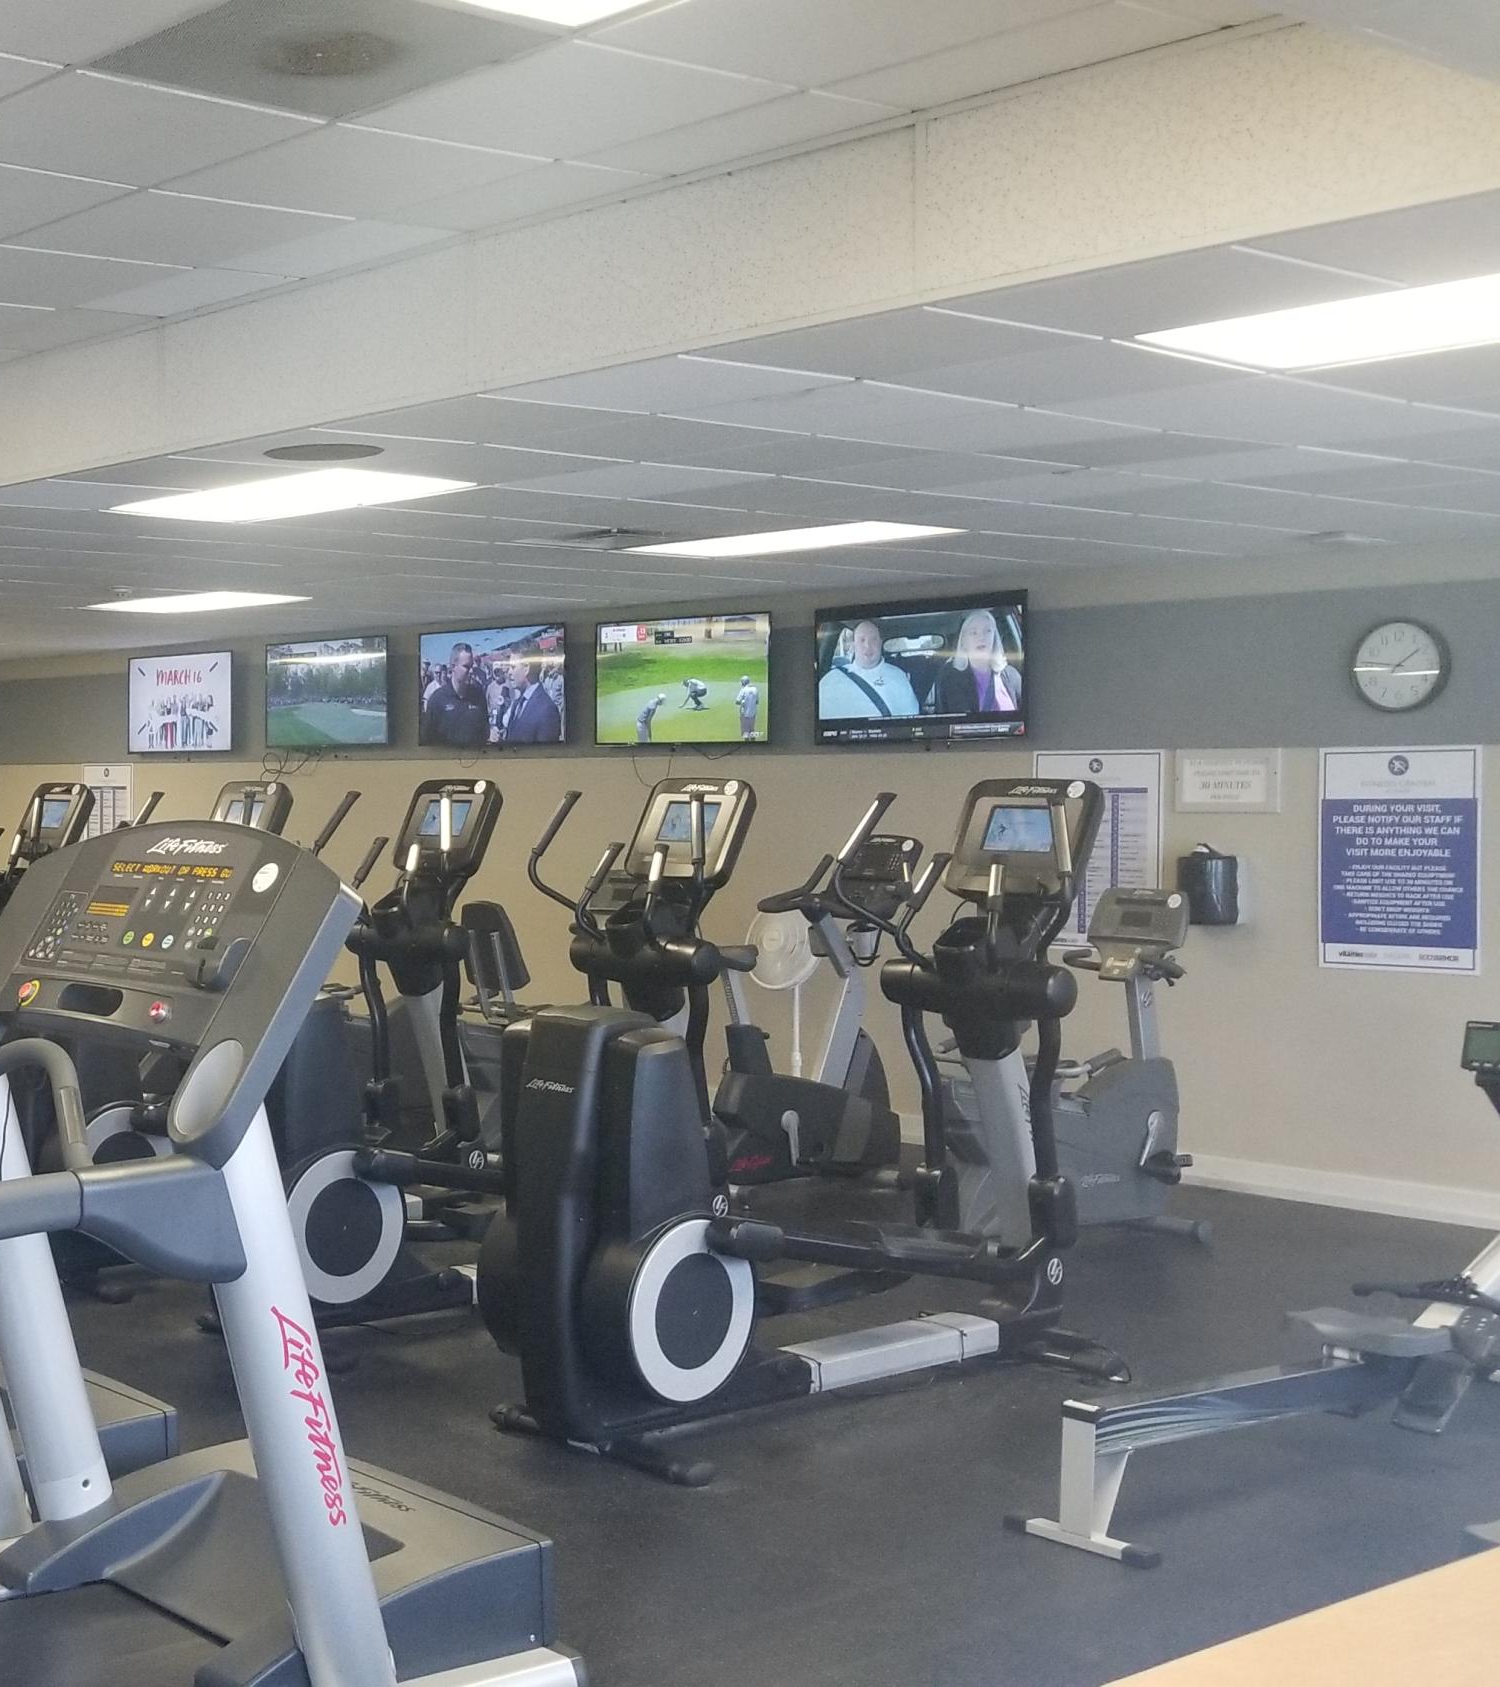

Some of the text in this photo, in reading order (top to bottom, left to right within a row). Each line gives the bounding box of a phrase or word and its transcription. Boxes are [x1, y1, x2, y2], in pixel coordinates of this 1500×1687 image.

[156, 668, 191, 686] MARCH
[1353, 804, 1387, 813] DURING
[1390, 804, 1414, 813] YOUR
[1332, 815, 1366, 824] PLEASE
[1367, 815, 1400, 824] NOTIFY
[1402, 815, 1422, 824] OUR
[1423, 815, 1453, 824] STAFF
[1335, 826, 1364, 835] THERE
[1376, 826, 1423, 835] ANYTHING
[1440, 826, 1461, 836] CAN
[1383, 837, 1411, 846] MAKE
[1412, 837, 1438, 846] YOUR
[1345, 848, 1452, 858] VISIT MORE ENJOYABLE
[112, 861, 140, 873] SELECT
[191, 866, 219, 878] PRESS
